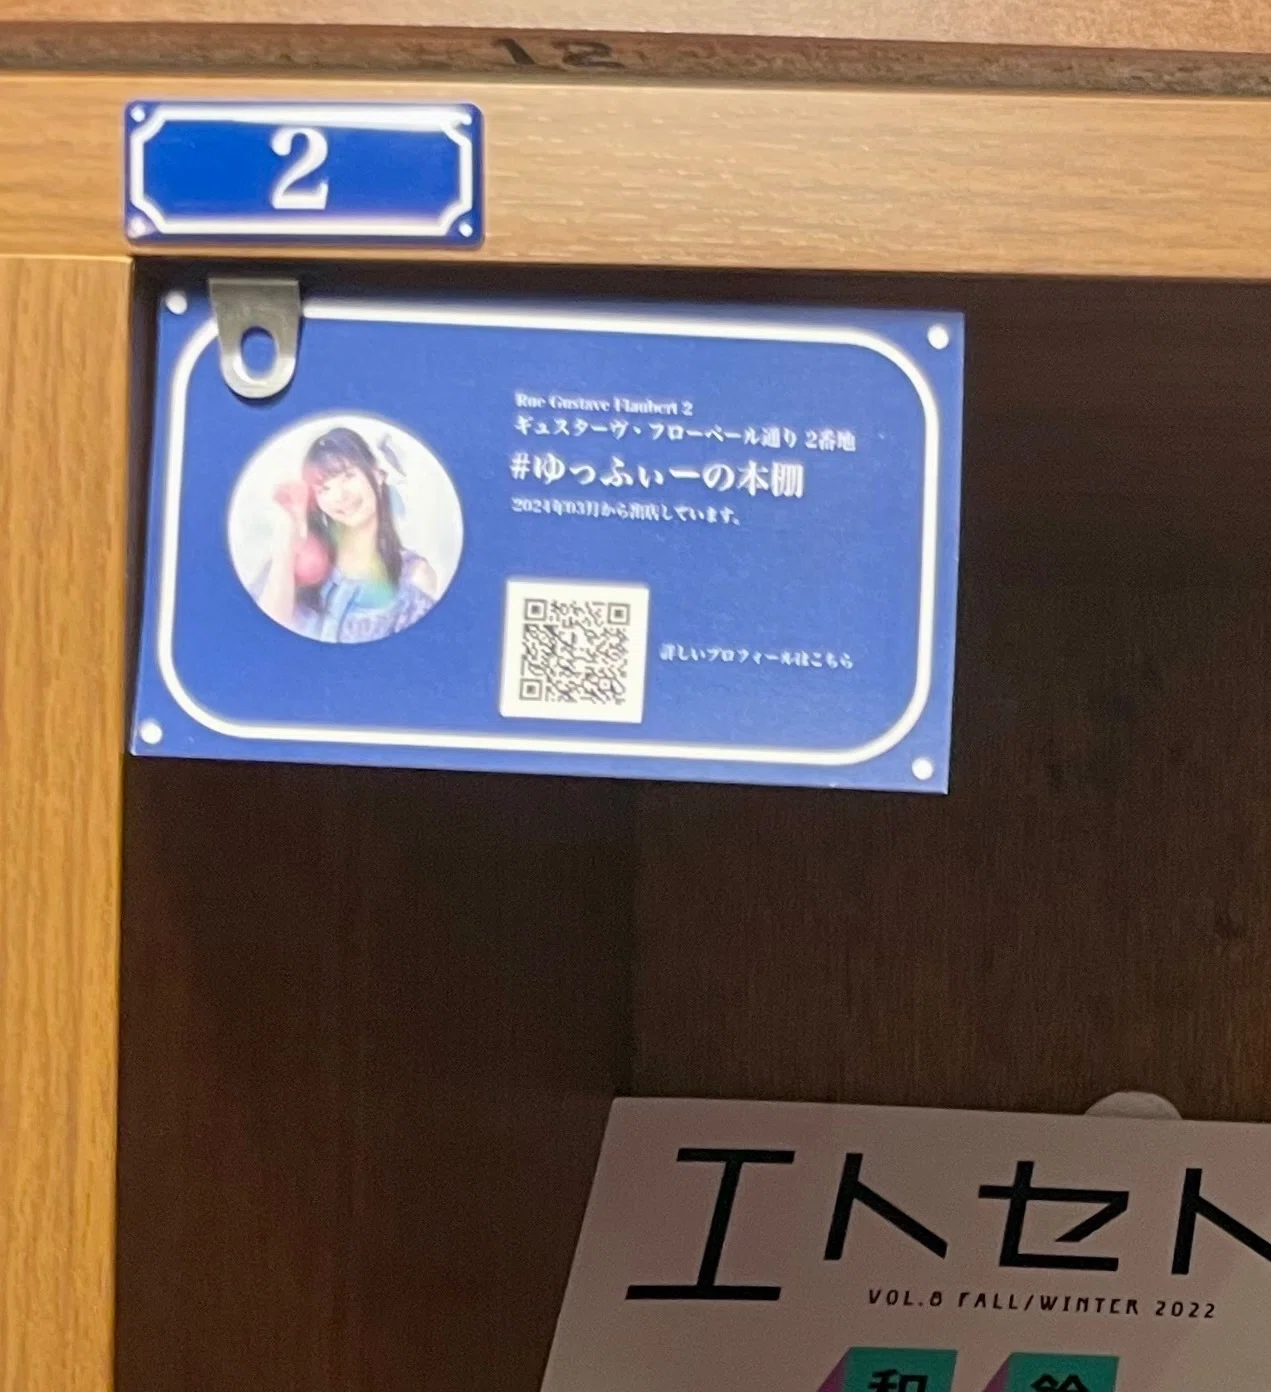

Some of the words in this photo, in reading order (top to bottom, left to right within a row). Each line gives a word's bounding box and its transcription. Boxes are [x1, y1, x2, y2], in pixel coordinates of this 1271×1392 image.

[270, 127, 330, 211] 2
[515, 391, 546, 408] Rue
[681, 400, 694, 416] 2
[509, 451, 804, 498] #ゆっふぃーの本棚
[867, 1288, 944, 1308] VOL.8
[1154, 1299, 1216, 1319] 2022
